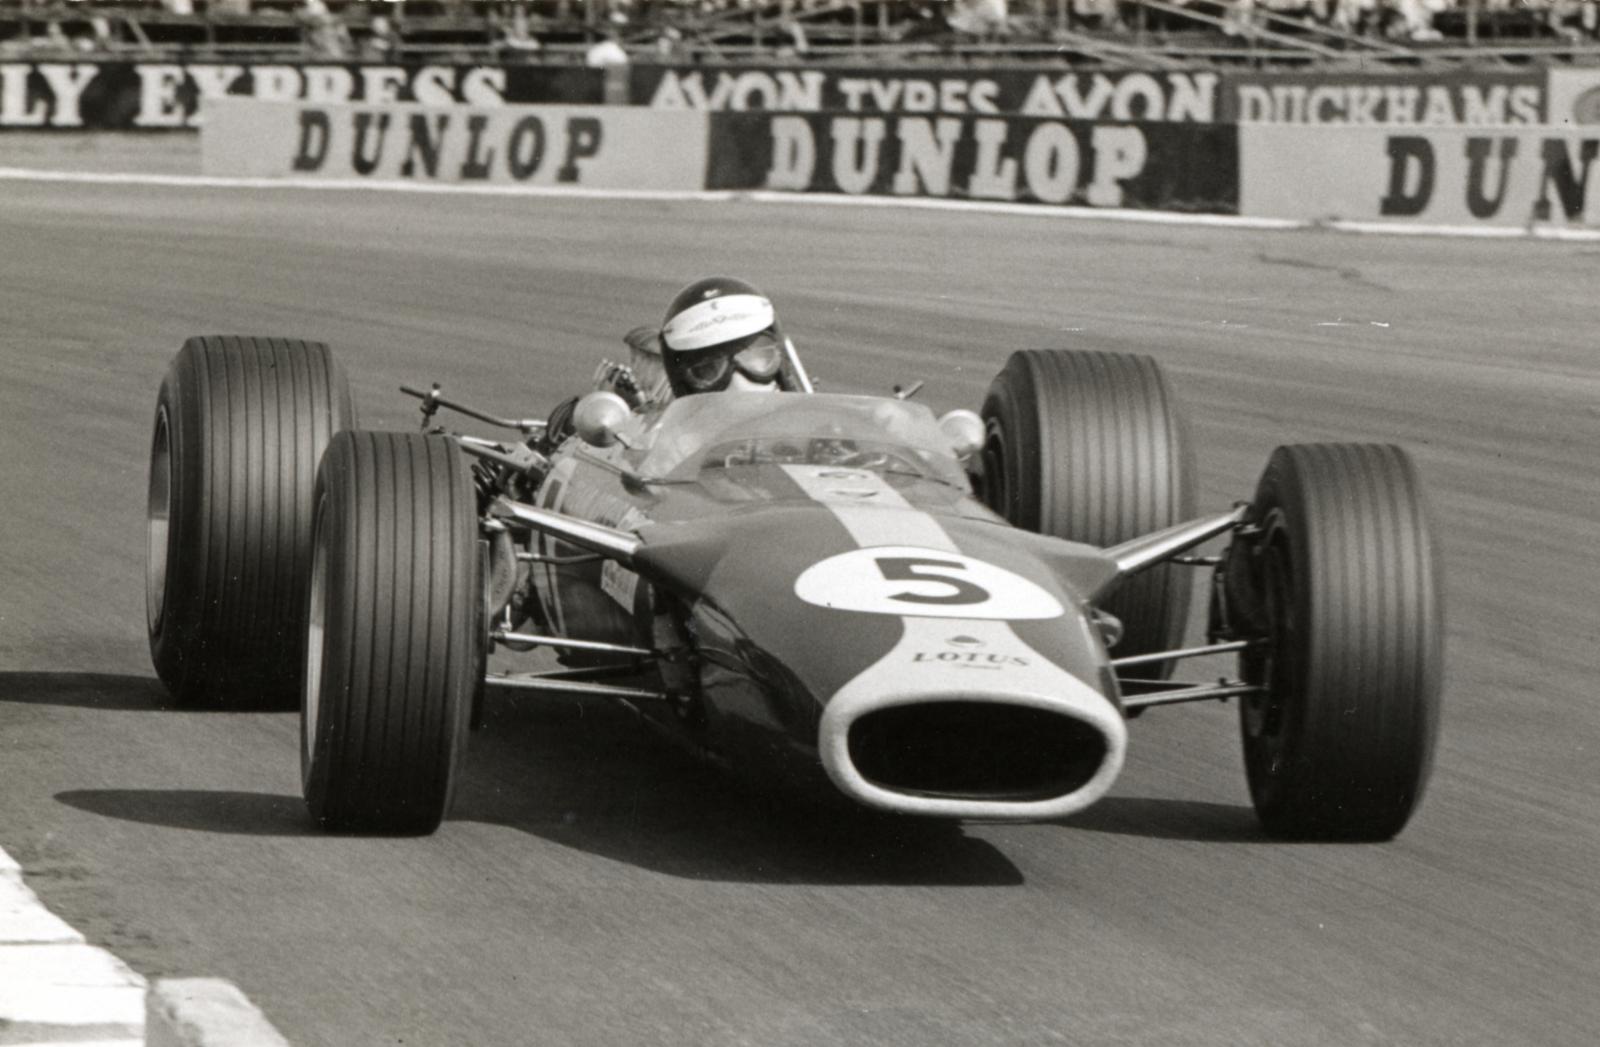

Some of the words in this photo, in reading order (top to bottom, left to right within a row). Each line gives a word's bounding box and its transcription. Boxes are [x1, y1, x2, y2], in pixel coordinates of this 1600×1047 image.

[0, 63, 100, 126] LY
[1020, 72, 1219, 122] AVON
[293, 109, 604, 183] DUNLOP
[766, 116, 1148, 207] DUNLOP
[1379, 136, 1599, 220] DUN
[875, 557, 991, 606] 5
[912, 652, 1030, 666] LOTUS
